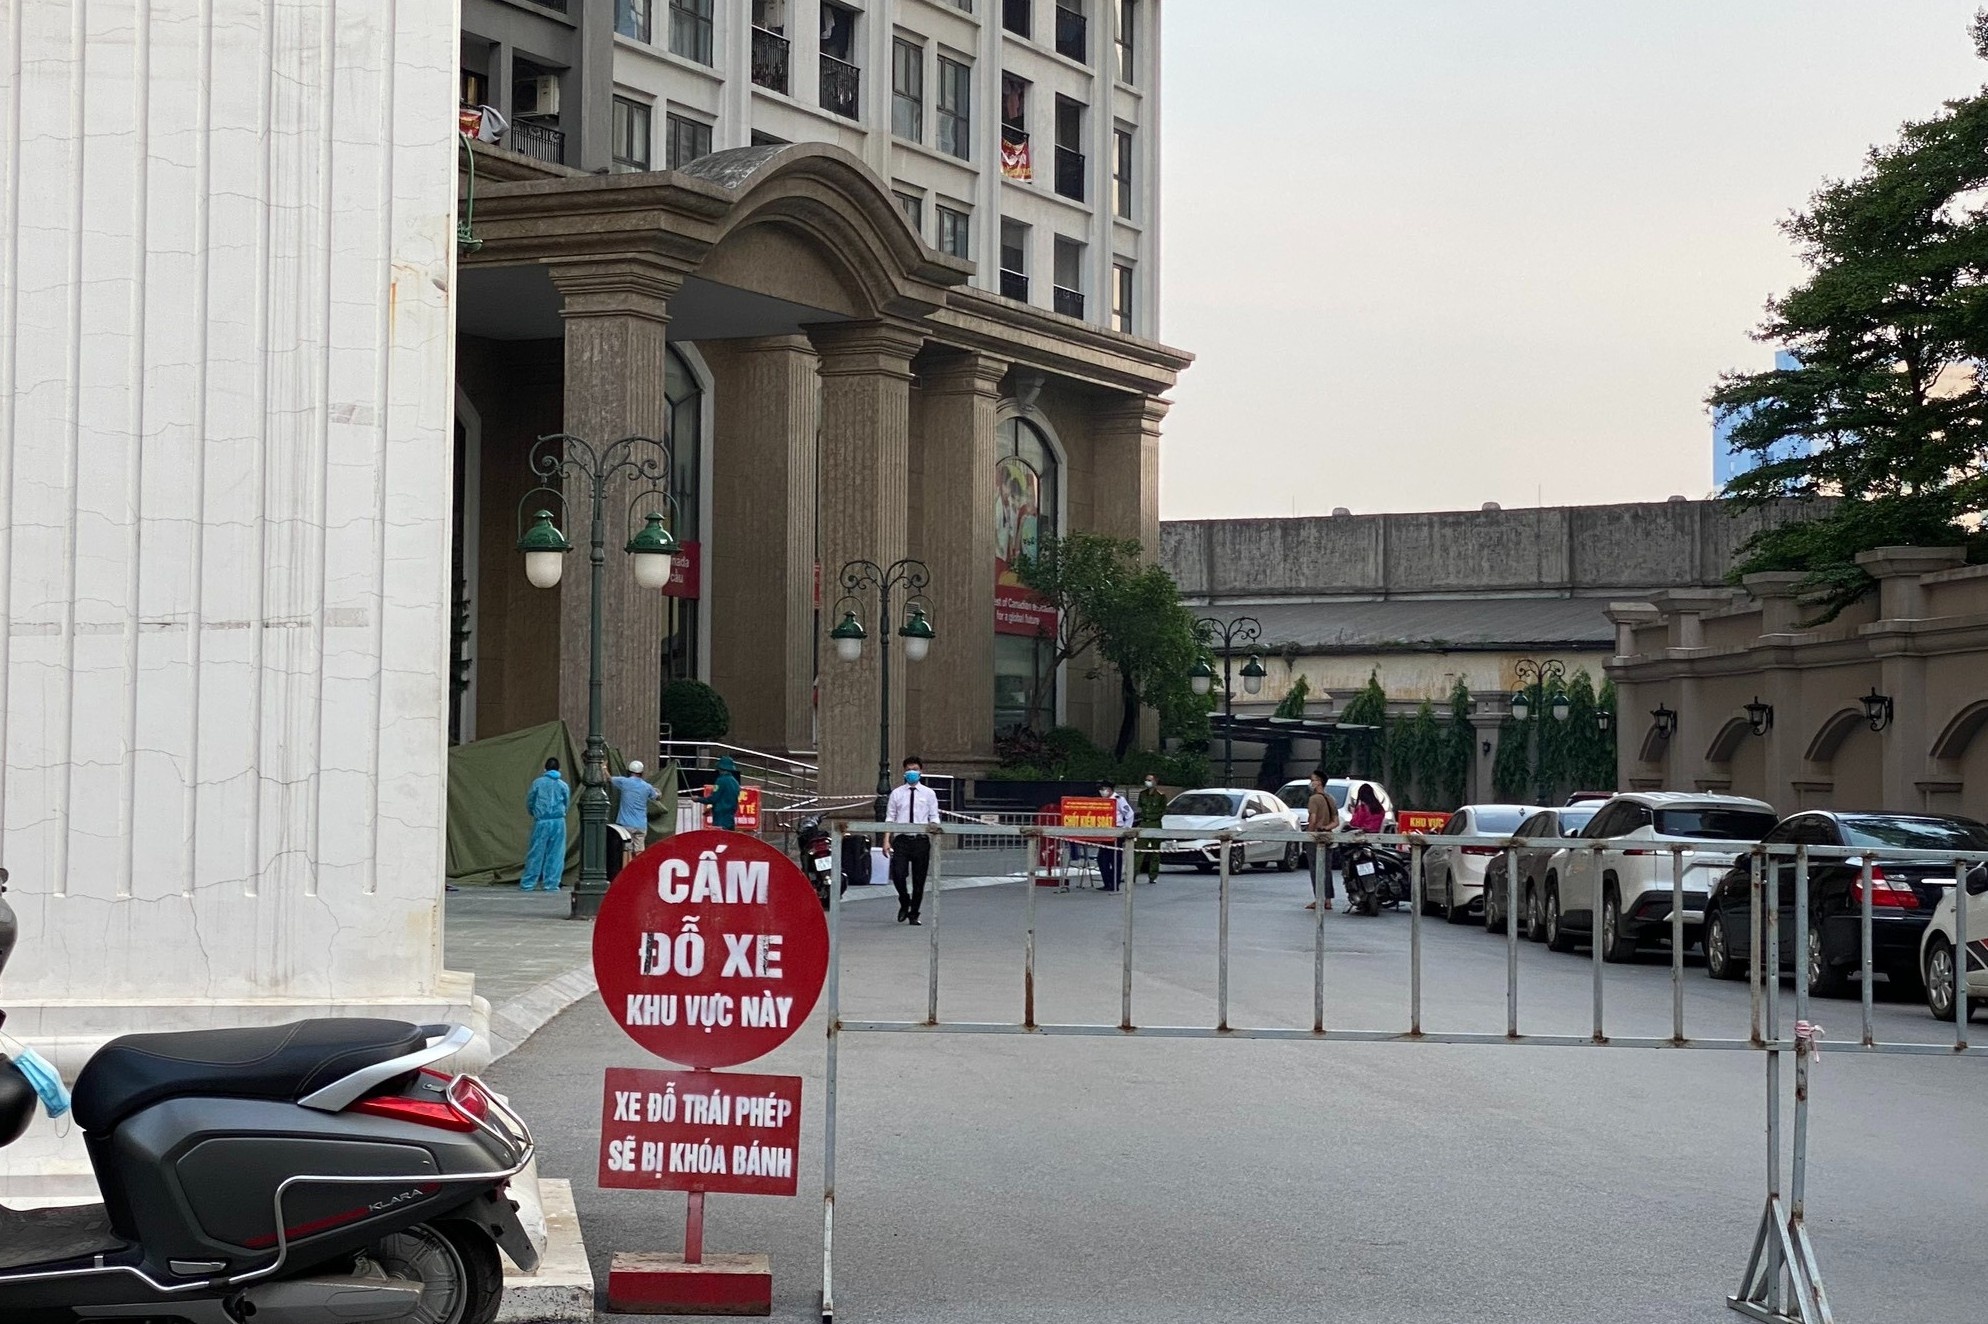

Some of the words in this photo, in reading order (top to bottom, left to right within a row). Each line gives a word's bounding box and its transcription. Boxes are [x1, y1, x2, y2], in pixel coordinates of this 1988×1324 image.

[658, 845, 770, 904] CẤM
[638, 915, 705, 977] ĐỖ
[720, 934, 783, 978] XE
[626, 994, 677, 1025] KHU
[684, 993, 734, 1033] VỰC
[741, 990, 793, 1028] NÀY
[613, 1091, 642, 1122] XE
[647, 1082, 677, 1123] ĐỖ
[682, 1089, 731, 1126] TRÁI
[735, 1091, 792, 1128] PHÉP
[608, 1135, 636, 1172] SẼ
[641, 1141, 664, 1179] BỊ
[669, 1137, 727, 1175] KHÓA
[732, 1140, 792, 1178] BÁNH
[368, 1188, 424, 1211] KLARA
